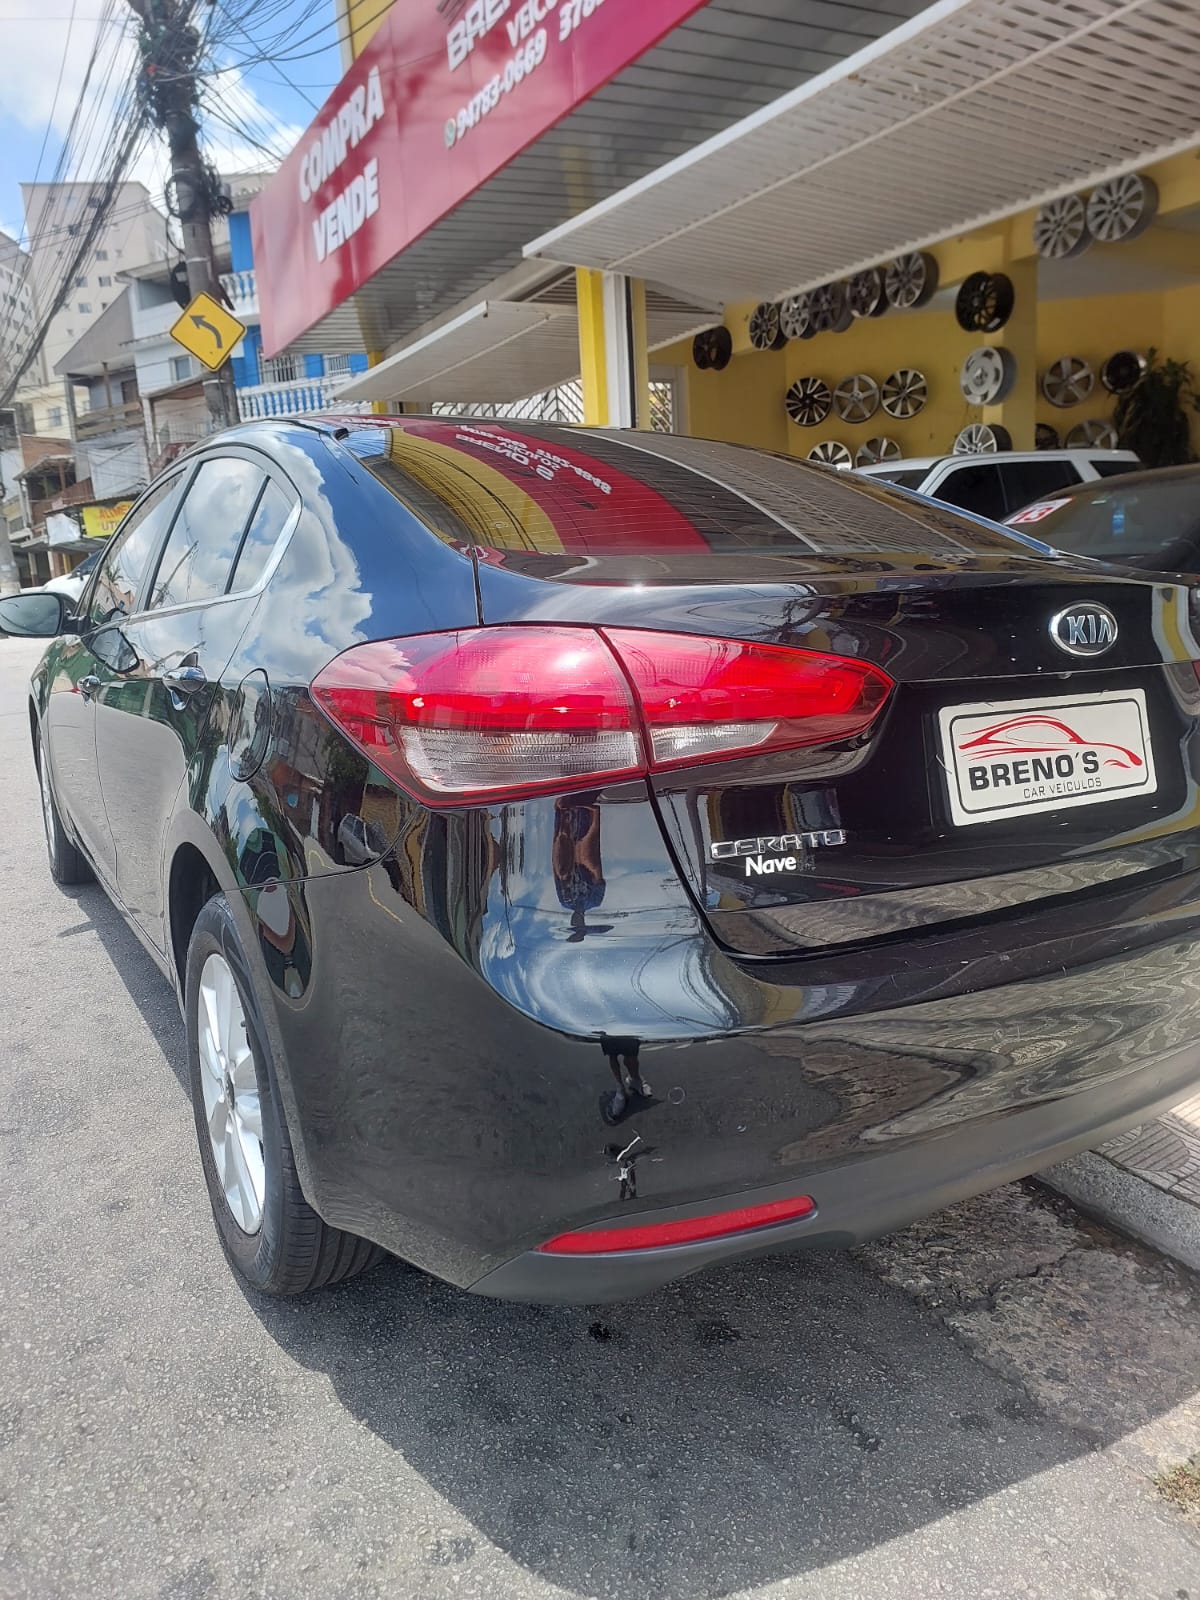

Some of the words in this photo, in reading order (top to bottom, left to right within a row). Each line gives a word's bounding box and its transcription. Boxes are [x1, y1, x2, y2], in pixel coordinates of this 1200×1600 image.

[446, 0, 511, 72] BRE
[505, 0, 559, 48] VEIC
[301, 65, 384, 202] COMPRA
[313, 157, 380, 264] VENDE
[1066, 614, 1113, 645] KIA
[968, 750, 1100, 792] BRENO'S
[1023, 785, 1045, 799] CAR
[1048, 777, 1102, 794] VEICULOS
[711, 829, 847, 859] CERATO
[745, 855, 797, 877] Nave
